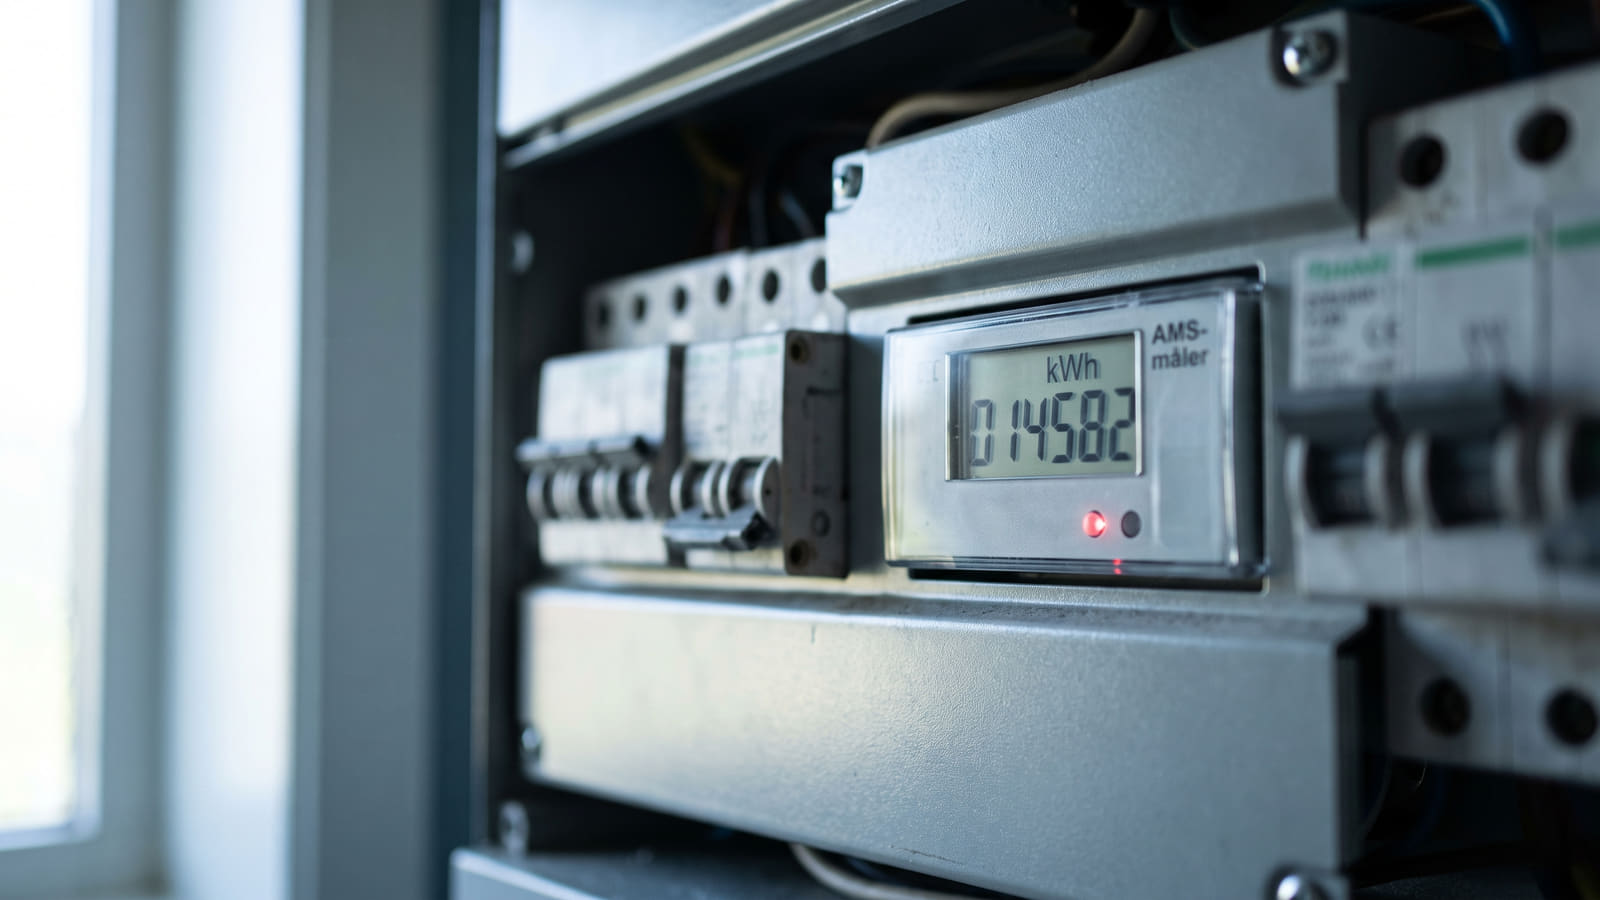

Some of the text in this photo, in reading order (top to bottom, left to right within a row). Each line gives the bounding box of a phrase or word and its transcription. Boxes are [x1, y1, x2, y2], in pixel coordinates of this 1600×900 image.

[1152, 320, 1208, 344] AMS-
[1047, 352, 1098, 384] kWh
[1152, 347, 1209, 371] måler
[971, 387, 1134, 467] 014582
